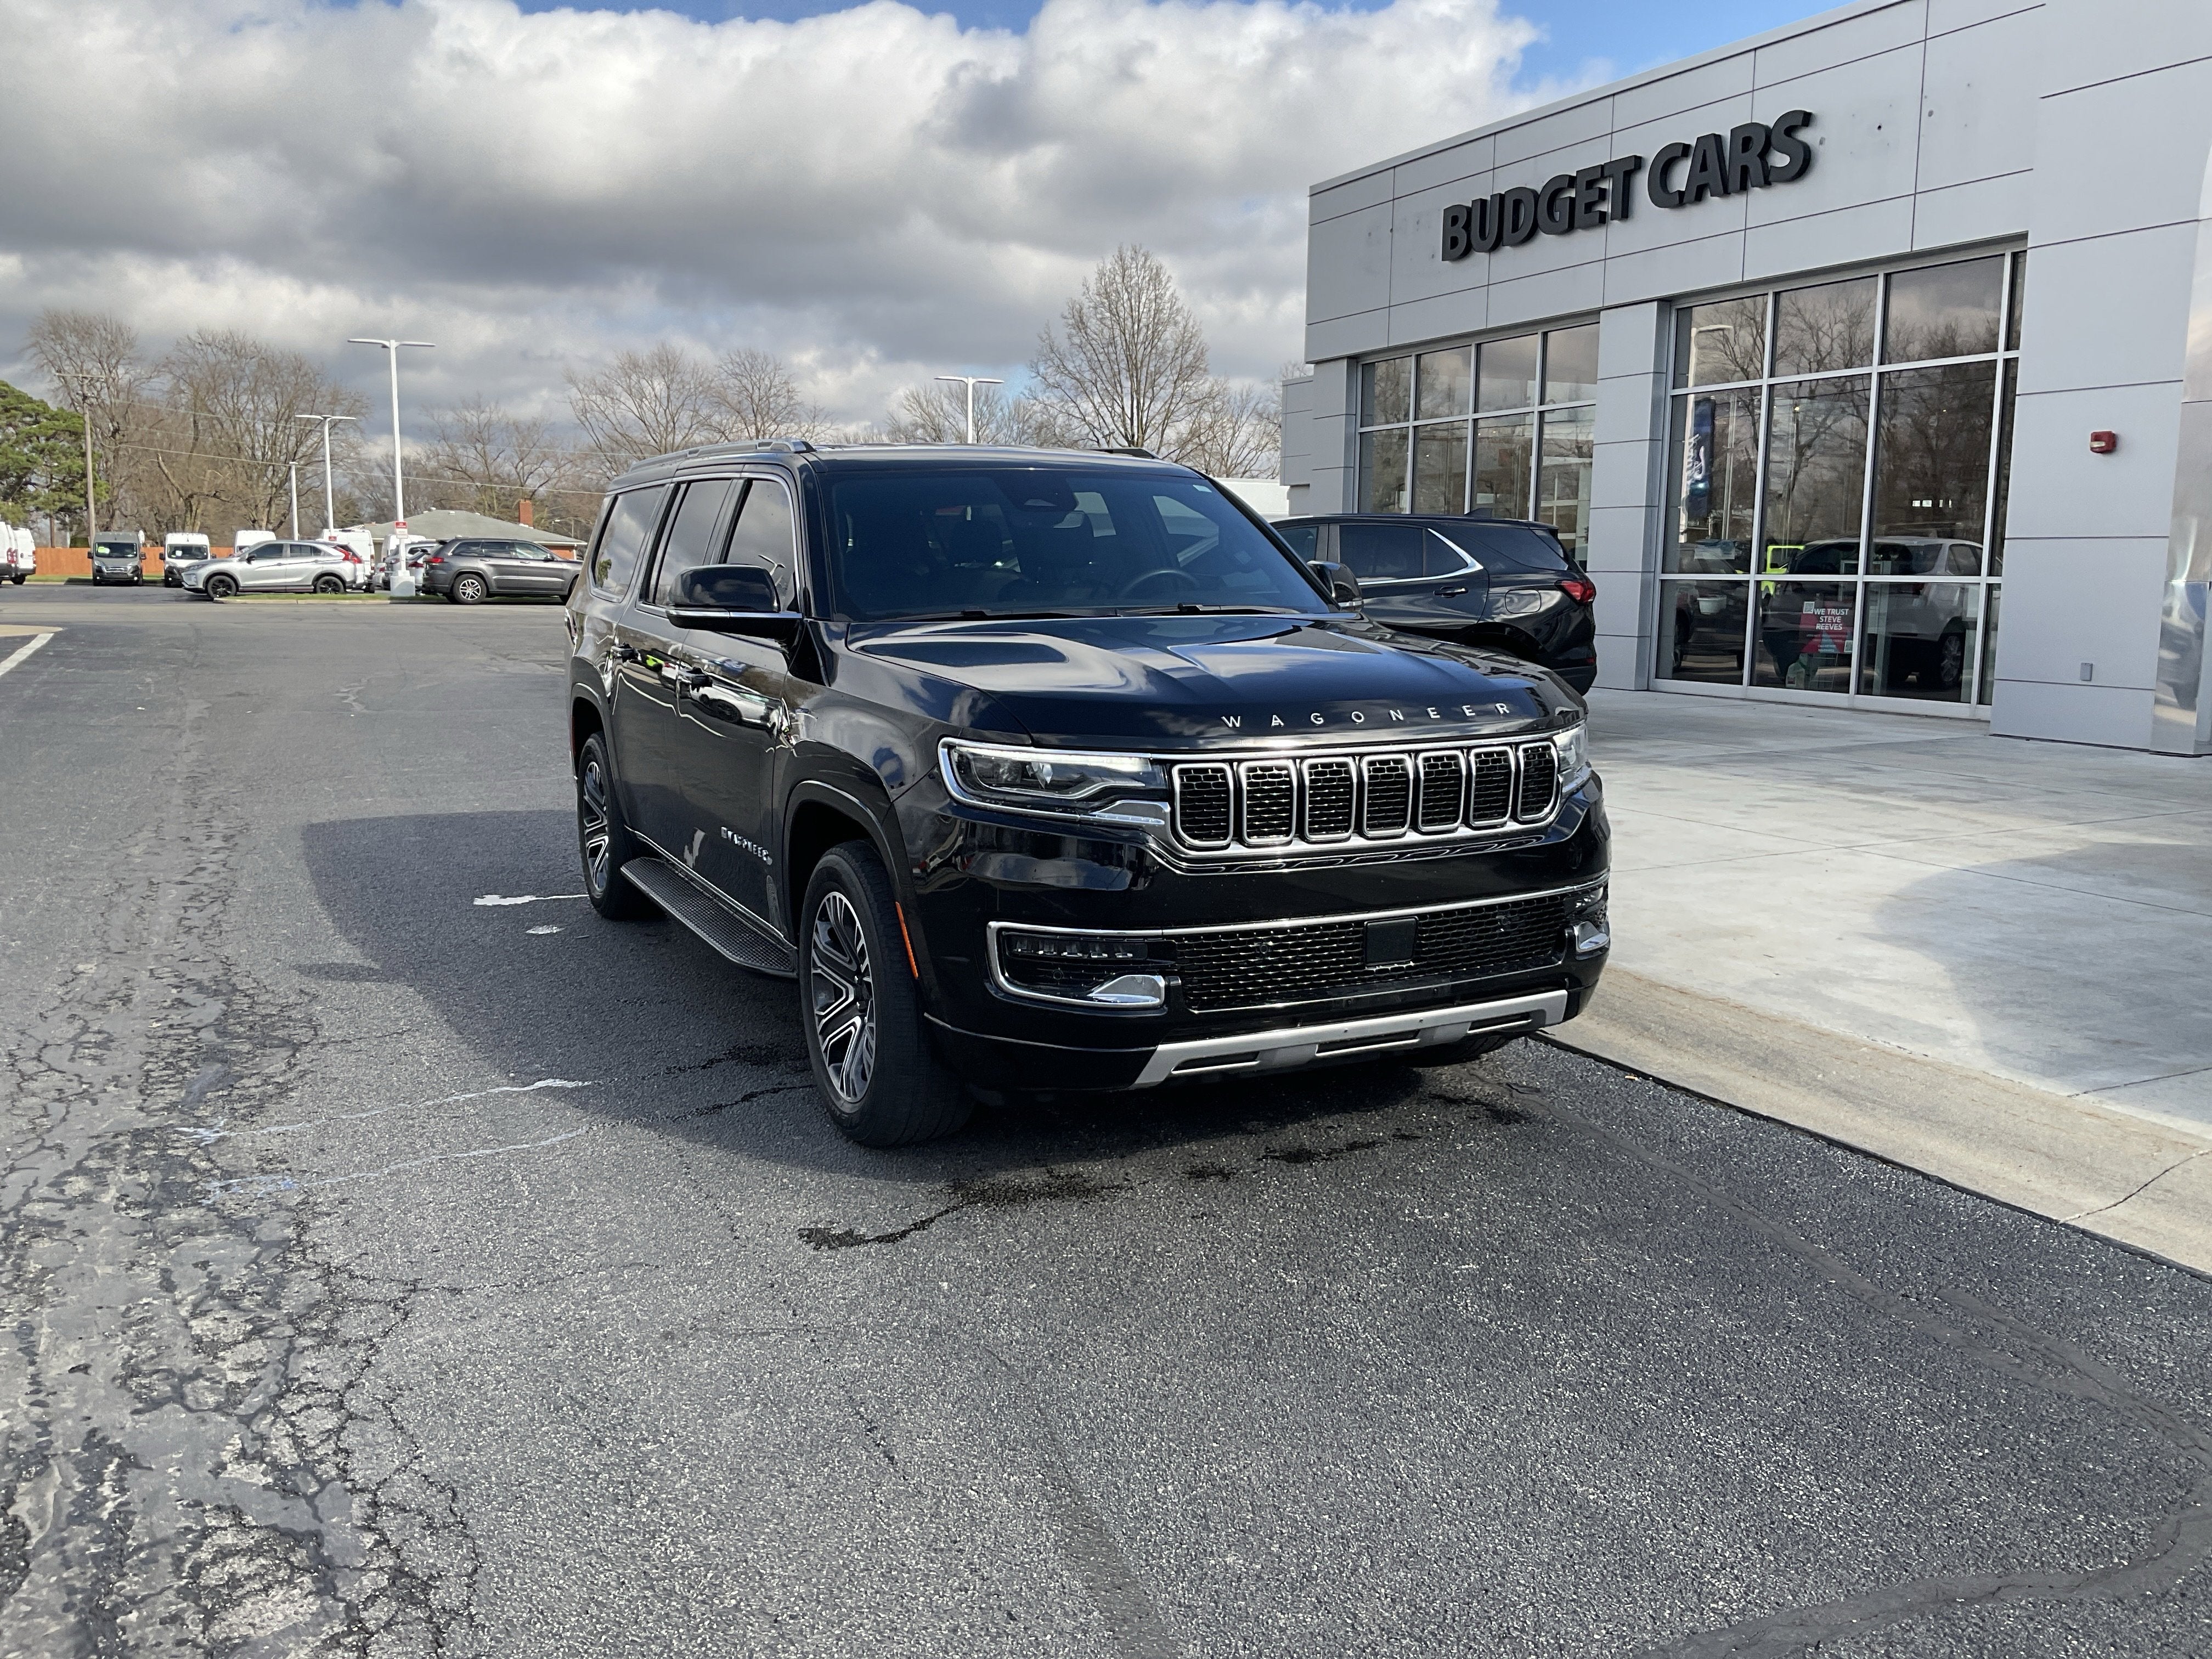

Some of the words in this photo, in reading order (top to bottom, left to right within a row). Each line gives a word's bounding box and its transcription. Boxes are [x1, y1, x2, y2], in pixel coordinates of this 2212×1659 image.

[1441, 154, 1642, 261] BUDGET
[1647, 110, 1813, 208] CARS
[1221, 702, 1510, 729] WAGONEER
